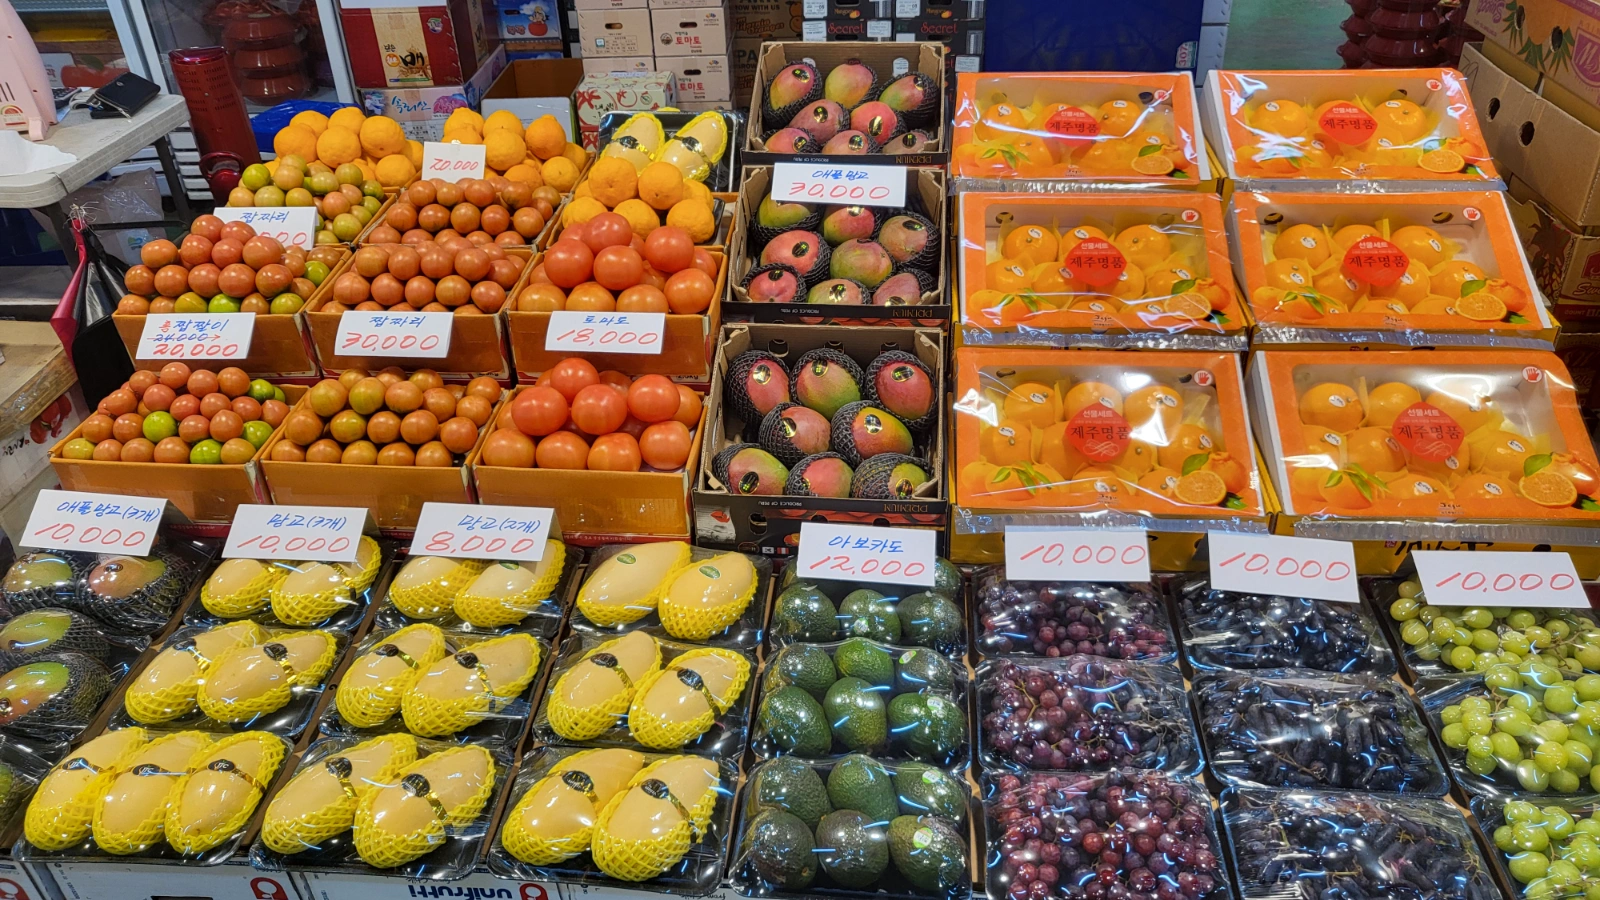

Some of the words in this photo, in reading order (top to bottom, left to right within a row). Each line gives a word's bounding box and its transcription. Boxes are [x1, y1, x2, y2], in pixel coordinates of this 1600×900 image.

[828, 22, 864, 34] Secret
[920, 22, 958, 34] Secret
[675, 36, 702, 45] 토마토
[1179, 45, 1188, 66] 307
[679, 82, 705, 91] 토마토
[392, 95, 432, 114] 속리산
[1332, 106, 1359, 114] 선물세트
[1049, 121, 1098, 134] 제주명품
[1323, 118, 1375, 130] 제주명품
[895, 156, 932, 164] PREMIUM
[240, 211, 290, 224] 짭짜리
[1080, 242, 1109, 250] 선물세트
[1358, 240, 1388, 249] 선물세트
[1070, 256, 1124, 269] 제주명품
[1348, 255, 1405, 269] 제주명품
[369, 315, 426, 328] 짭짜리
[583, 315, 630, 326] 토마토
[556, 328, 658, 346] 18,000
[153, 344, 238, 358] 20,000
[1083, 409, 1113, 418] 선물세트
[1407, 408, 1440, 417] 선물세트
[1070, 427, 1128, 440] 제주명품
[1398, 425, 1461, 441] 제주명품
[883, 503, 928, 513] PREMIUM
[34, 523, 146, 546] 10,000
[237, 535, 350, 553] 10,000
[425, 531, 534, 554] 8,000
[828, 535, 904, 553] 아보카도
[1020, 543, 1146, 566] 10,000
[1219, 552, 1350, 581] 10,000
[408, 885, 512, 900] unifrutti
